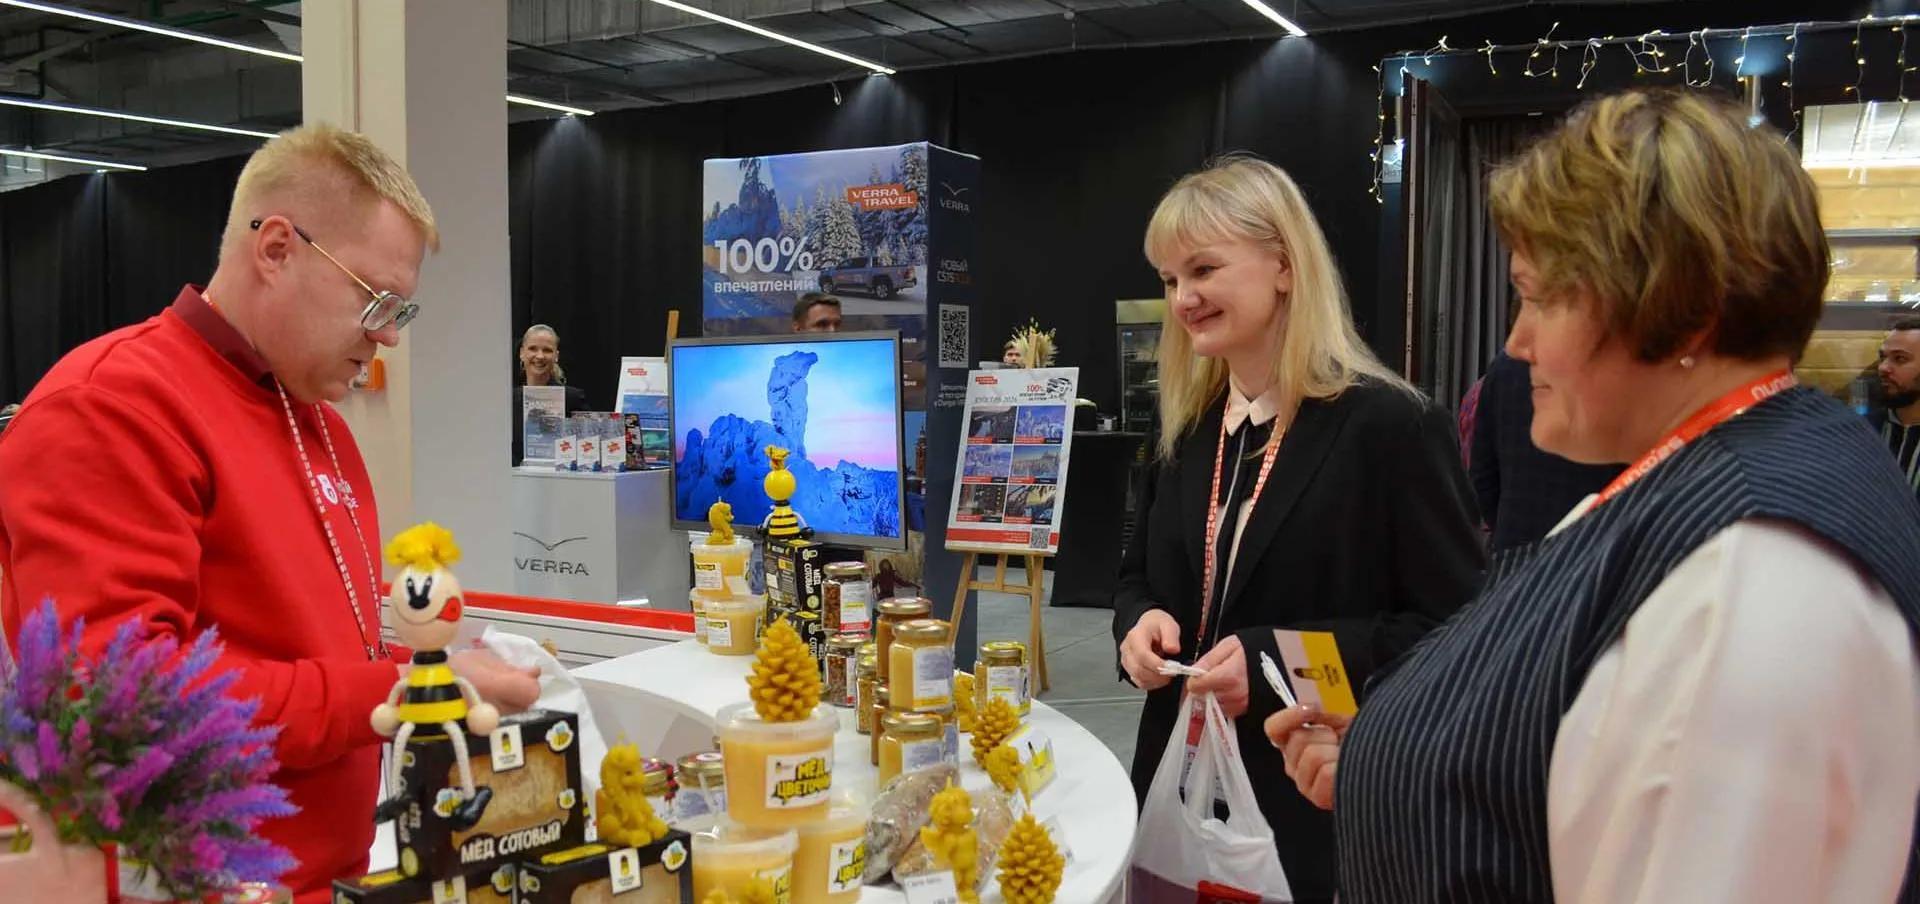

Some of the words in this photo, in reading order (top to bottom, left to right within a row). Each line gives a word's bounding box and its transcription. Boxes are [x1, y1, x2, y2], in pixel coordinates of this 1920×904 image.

[852, 188, 899, 199] VERRA
[863, 196, 913, 207] TRAVEL
[939, 197, 970, 212] VERRA
[714, 236, 814, 274] 100%
[714, 279, 815, 293] впечатлений
[514, 556, 590, 576] VERRA
[460, 837, 495, 864] МЁД
[498, 821, 562, 855] СОТОВЫЙ
